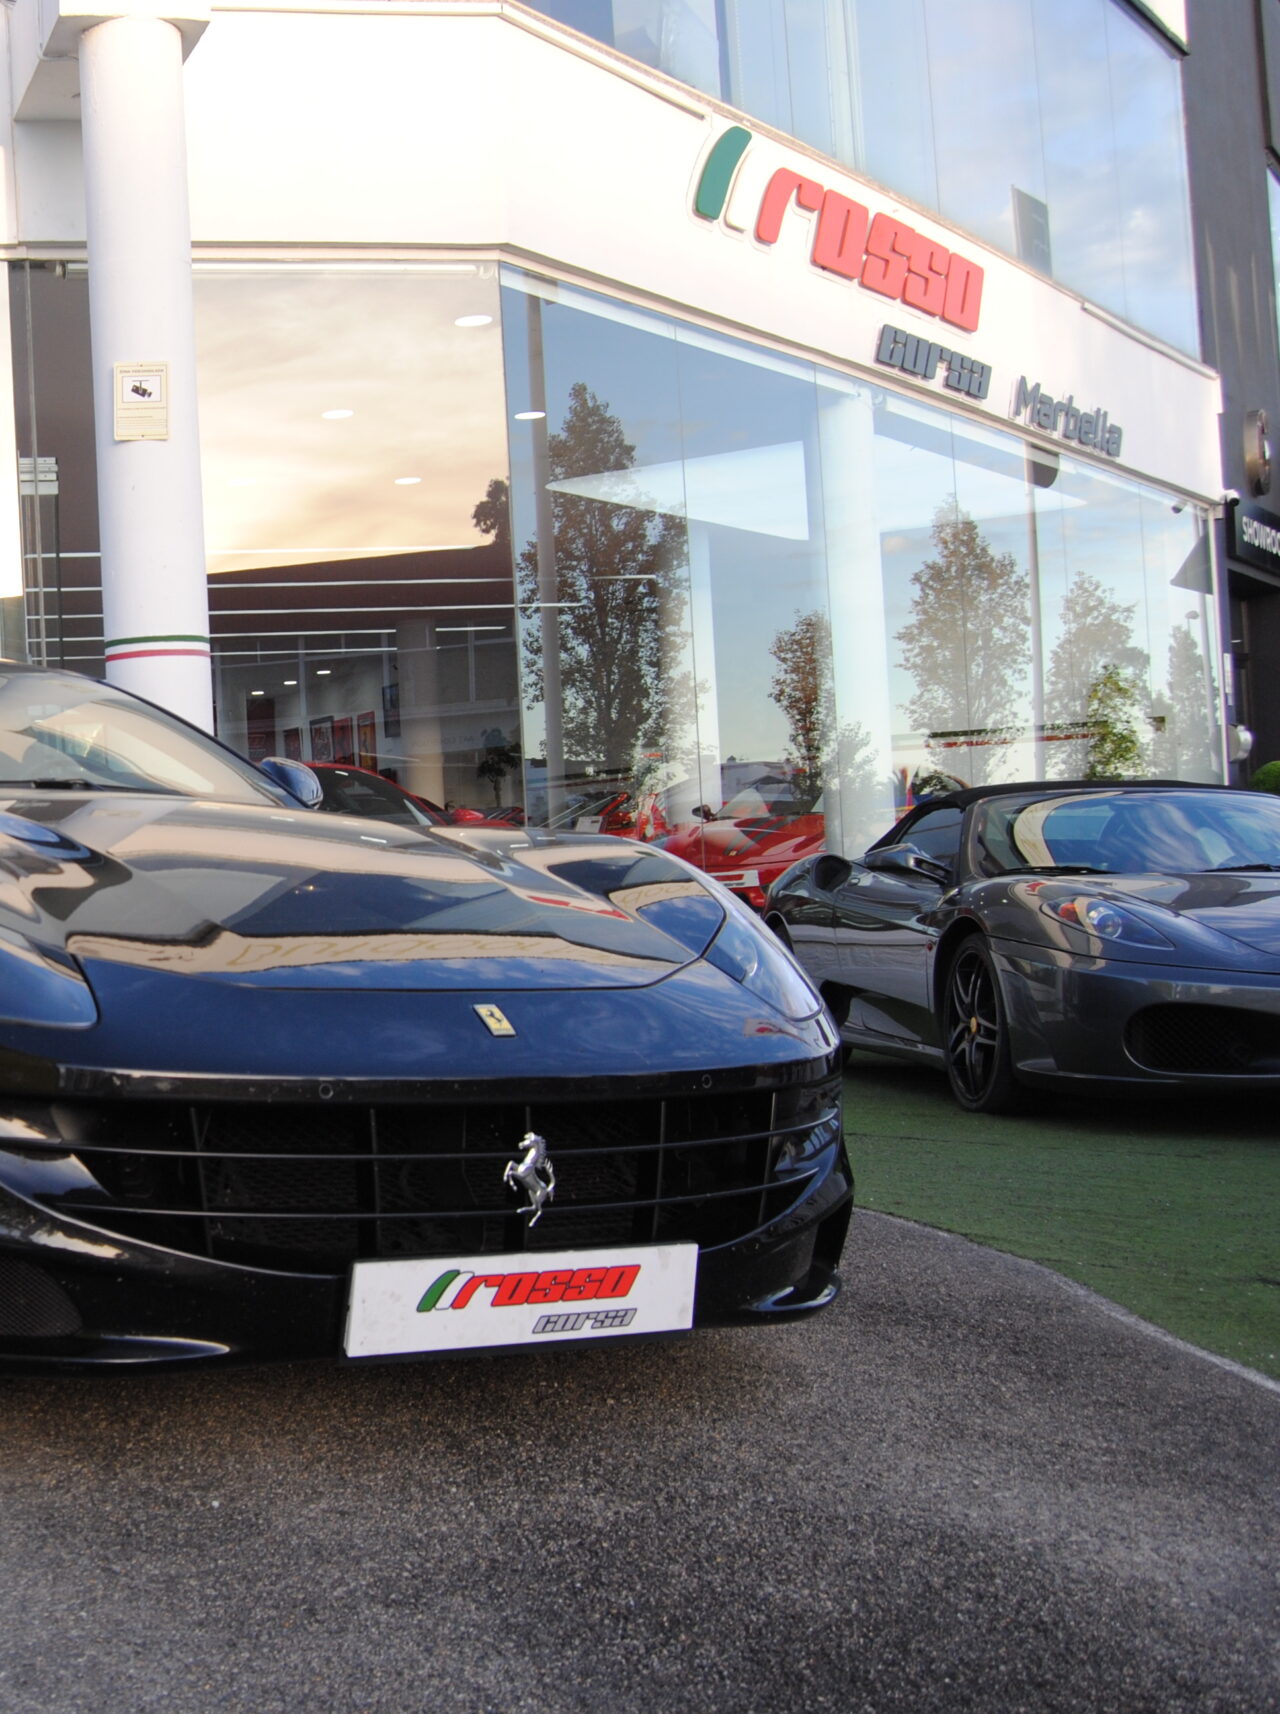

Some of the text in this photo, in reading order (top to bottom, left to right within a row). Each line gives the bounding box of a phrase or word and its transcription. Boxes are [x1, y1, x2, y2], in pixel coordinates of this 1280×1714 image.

[755, 167, 984, 333] rosso
[875, 323, 992, 399] corsa
[1015, 375, 1122, 457] Marbella
[451, 1264, 641, 1310] rosso
[532, 1308, 638, 1334] corsa
